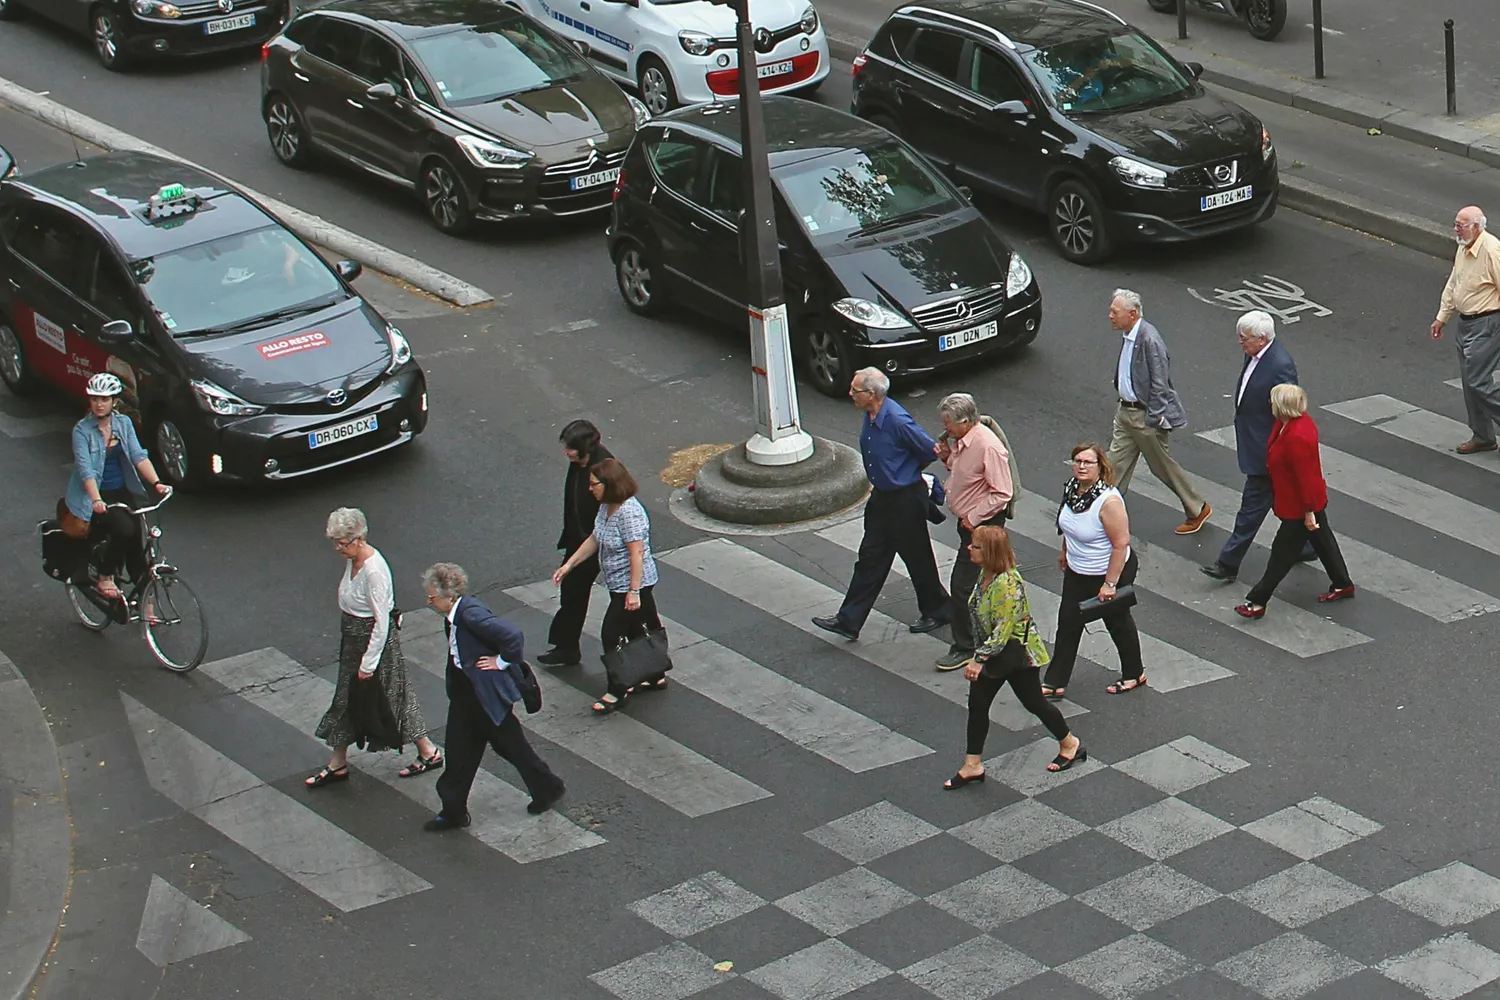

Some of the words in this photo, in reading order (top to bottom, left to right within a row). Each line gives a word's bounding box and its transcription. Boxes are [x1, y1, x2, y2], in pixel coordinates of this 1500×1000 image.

[262, 341, 288, 353] ALLO
[288, 333, 324, 346] RESTO
[946, 335, 957, 347] 61
[985, 322, 996, 335] 75
